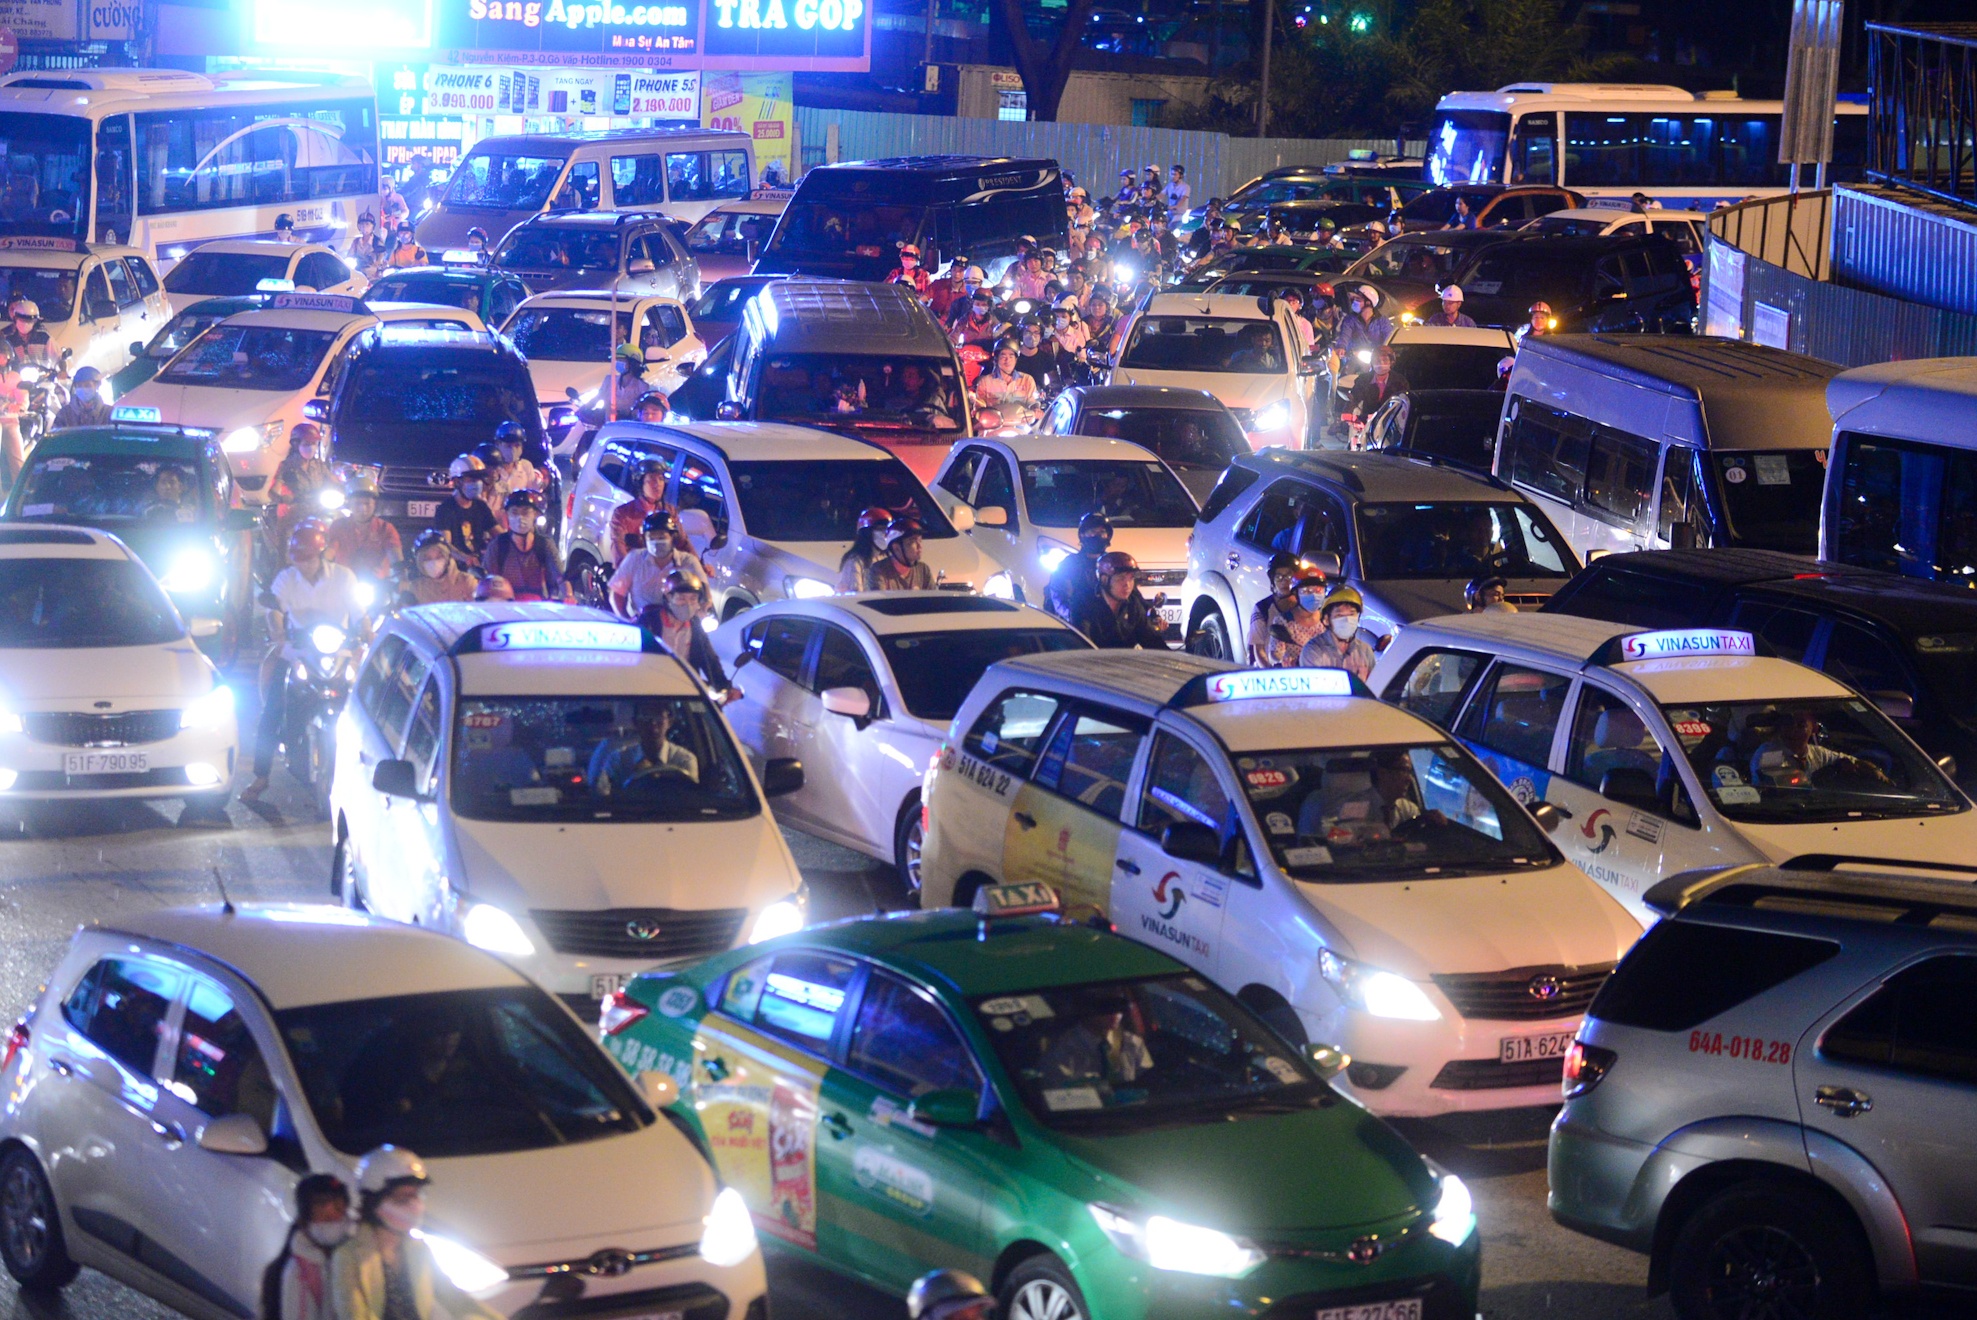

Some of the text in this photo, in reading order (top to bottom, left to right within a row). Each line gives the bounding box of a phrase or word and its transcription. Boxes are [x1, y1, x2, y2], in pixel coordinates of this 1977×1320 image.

[470, 0, 687, 28] Sang Apple.com
[655, 36, 671, 48] An
[647, 57, 673, 67] 0304
[435, 73, 493, 88] IPHONE 6
[633, 78, 678, 92] IPHONE
[118, 408, 155, 419] TAXI
[1729, 469, 1744, 480] 01
[521, 628, 637, 646] VINASUNAXI
[1675, 722, 1711, 734] 8396
[1572, 858, 1639, 893] INASUNTAXI
[991, 884, 1050, 906] TAXI
[1689, 1030, 1791, 1065] 64A-018.28
